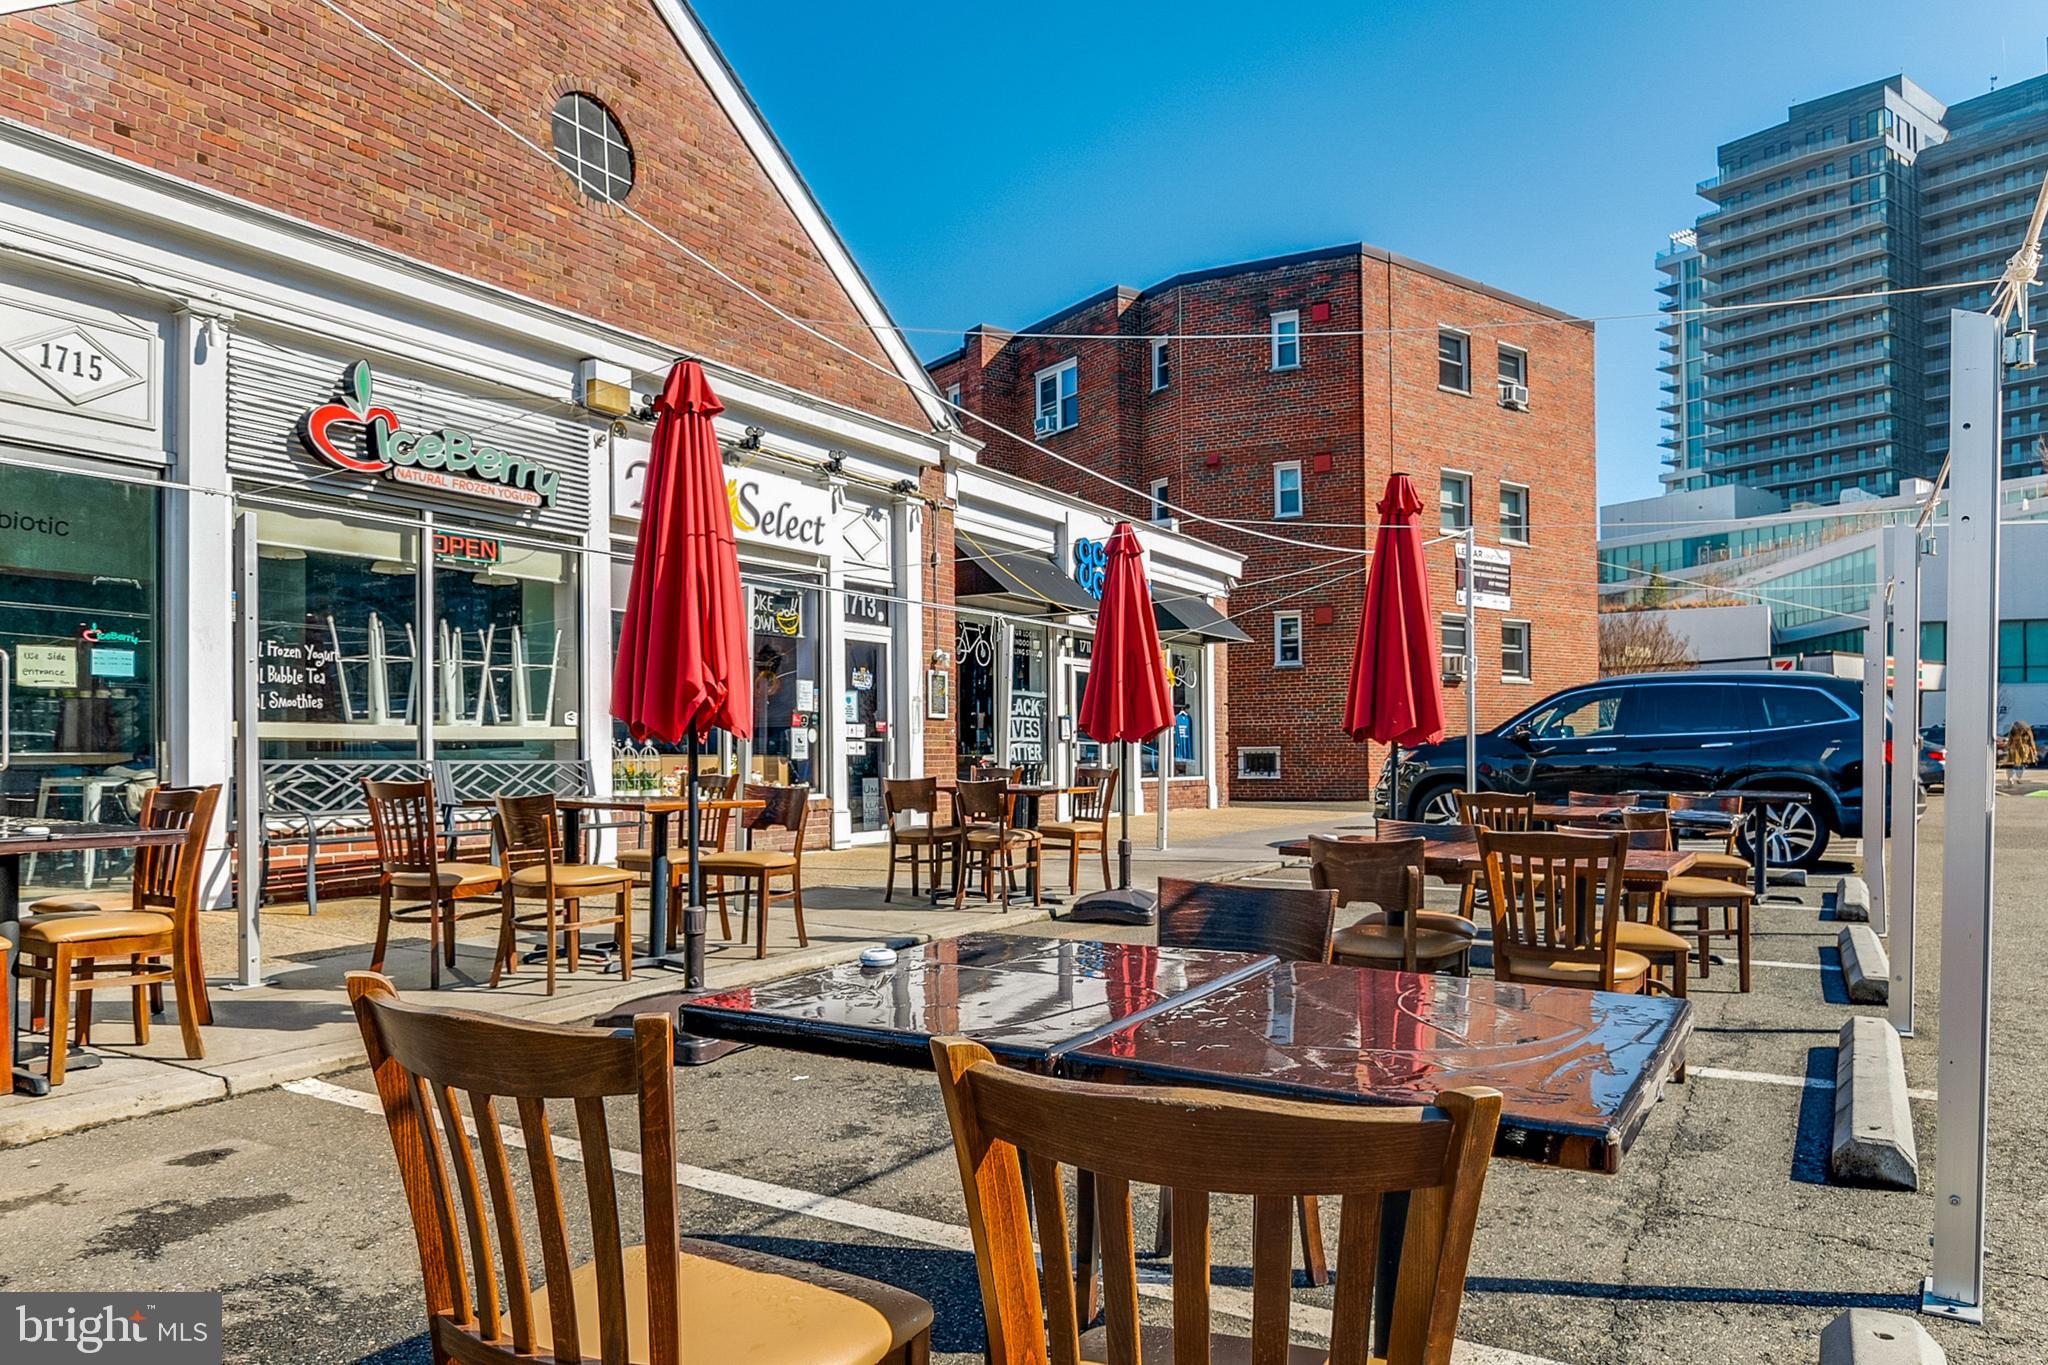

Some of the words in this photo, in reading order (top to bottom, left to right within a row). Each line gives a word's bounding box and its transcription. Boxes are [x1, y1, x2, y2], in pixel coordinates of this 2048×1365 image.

[39, 343, 103, 382] 1715
[374, 415, 561, 509] IceBerry
[396, 466, 449, 487] NATURAL
[451, 479, 497, 497] FROZEN
[497, 486, 540, 504] YOGURT
[737, 481, 827, 546] Select
[433, 533, 498, 561] OPEN
[267, 640, 302, 658] Frozen
[267, 665, 304, 685] Bubble
[306, 668, 326, 685] Tea
[268, 691, 324, 709] Smoothies
[1010, 719, 1040, 738] IVES
[1010, 743, 1043, 761] ATTER
